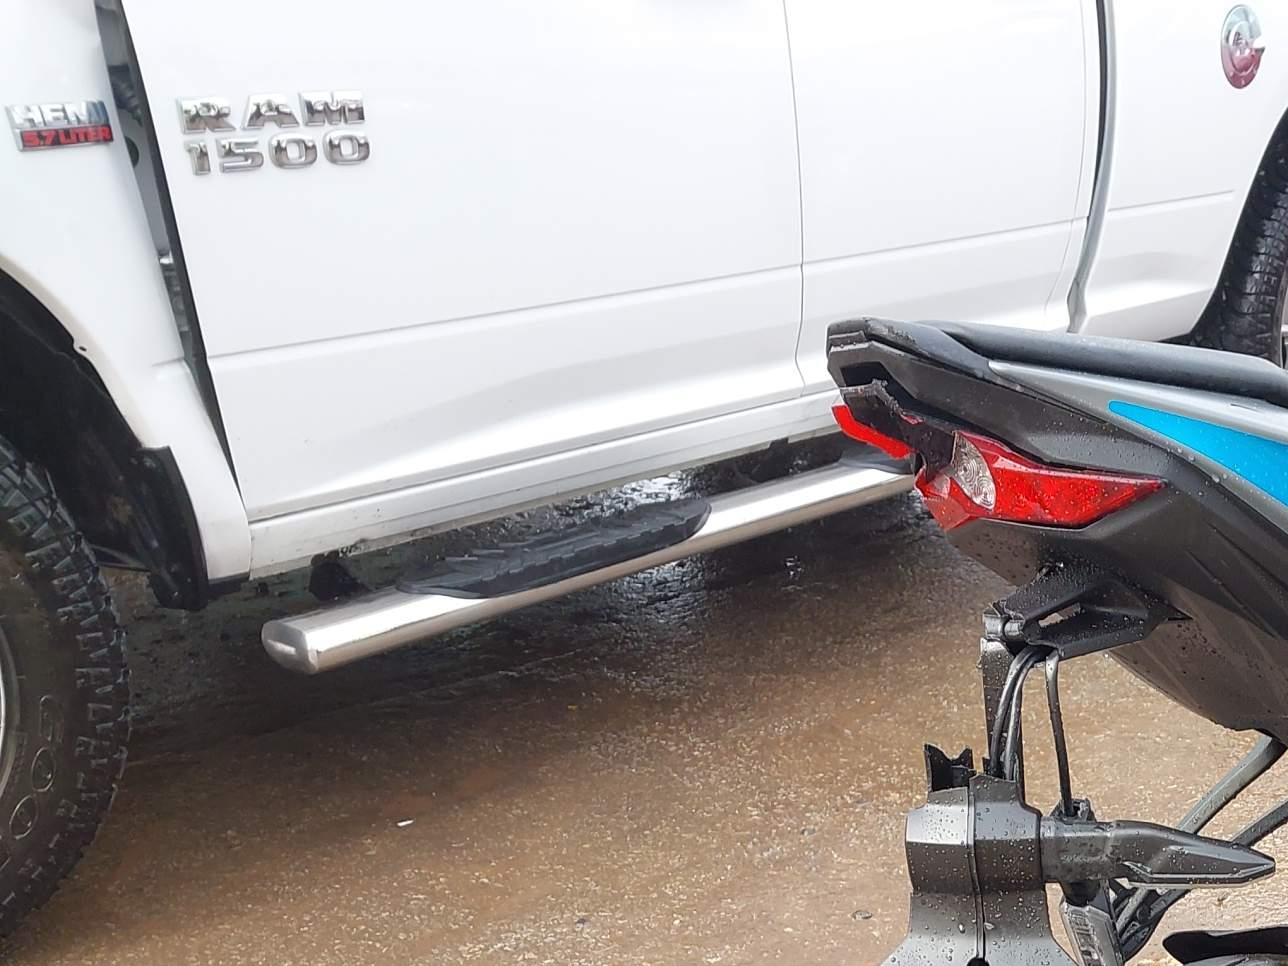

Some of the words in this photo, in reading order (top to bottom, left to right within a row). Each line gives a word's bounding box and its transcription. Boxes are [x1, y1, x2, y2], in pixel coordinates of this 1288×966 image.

[176, 91, 366, 134] RAM
[22, 130, 56, 146] 5.7
[59, 126, 111, 144] LITER
[184, 129, 371, 175] 1500
